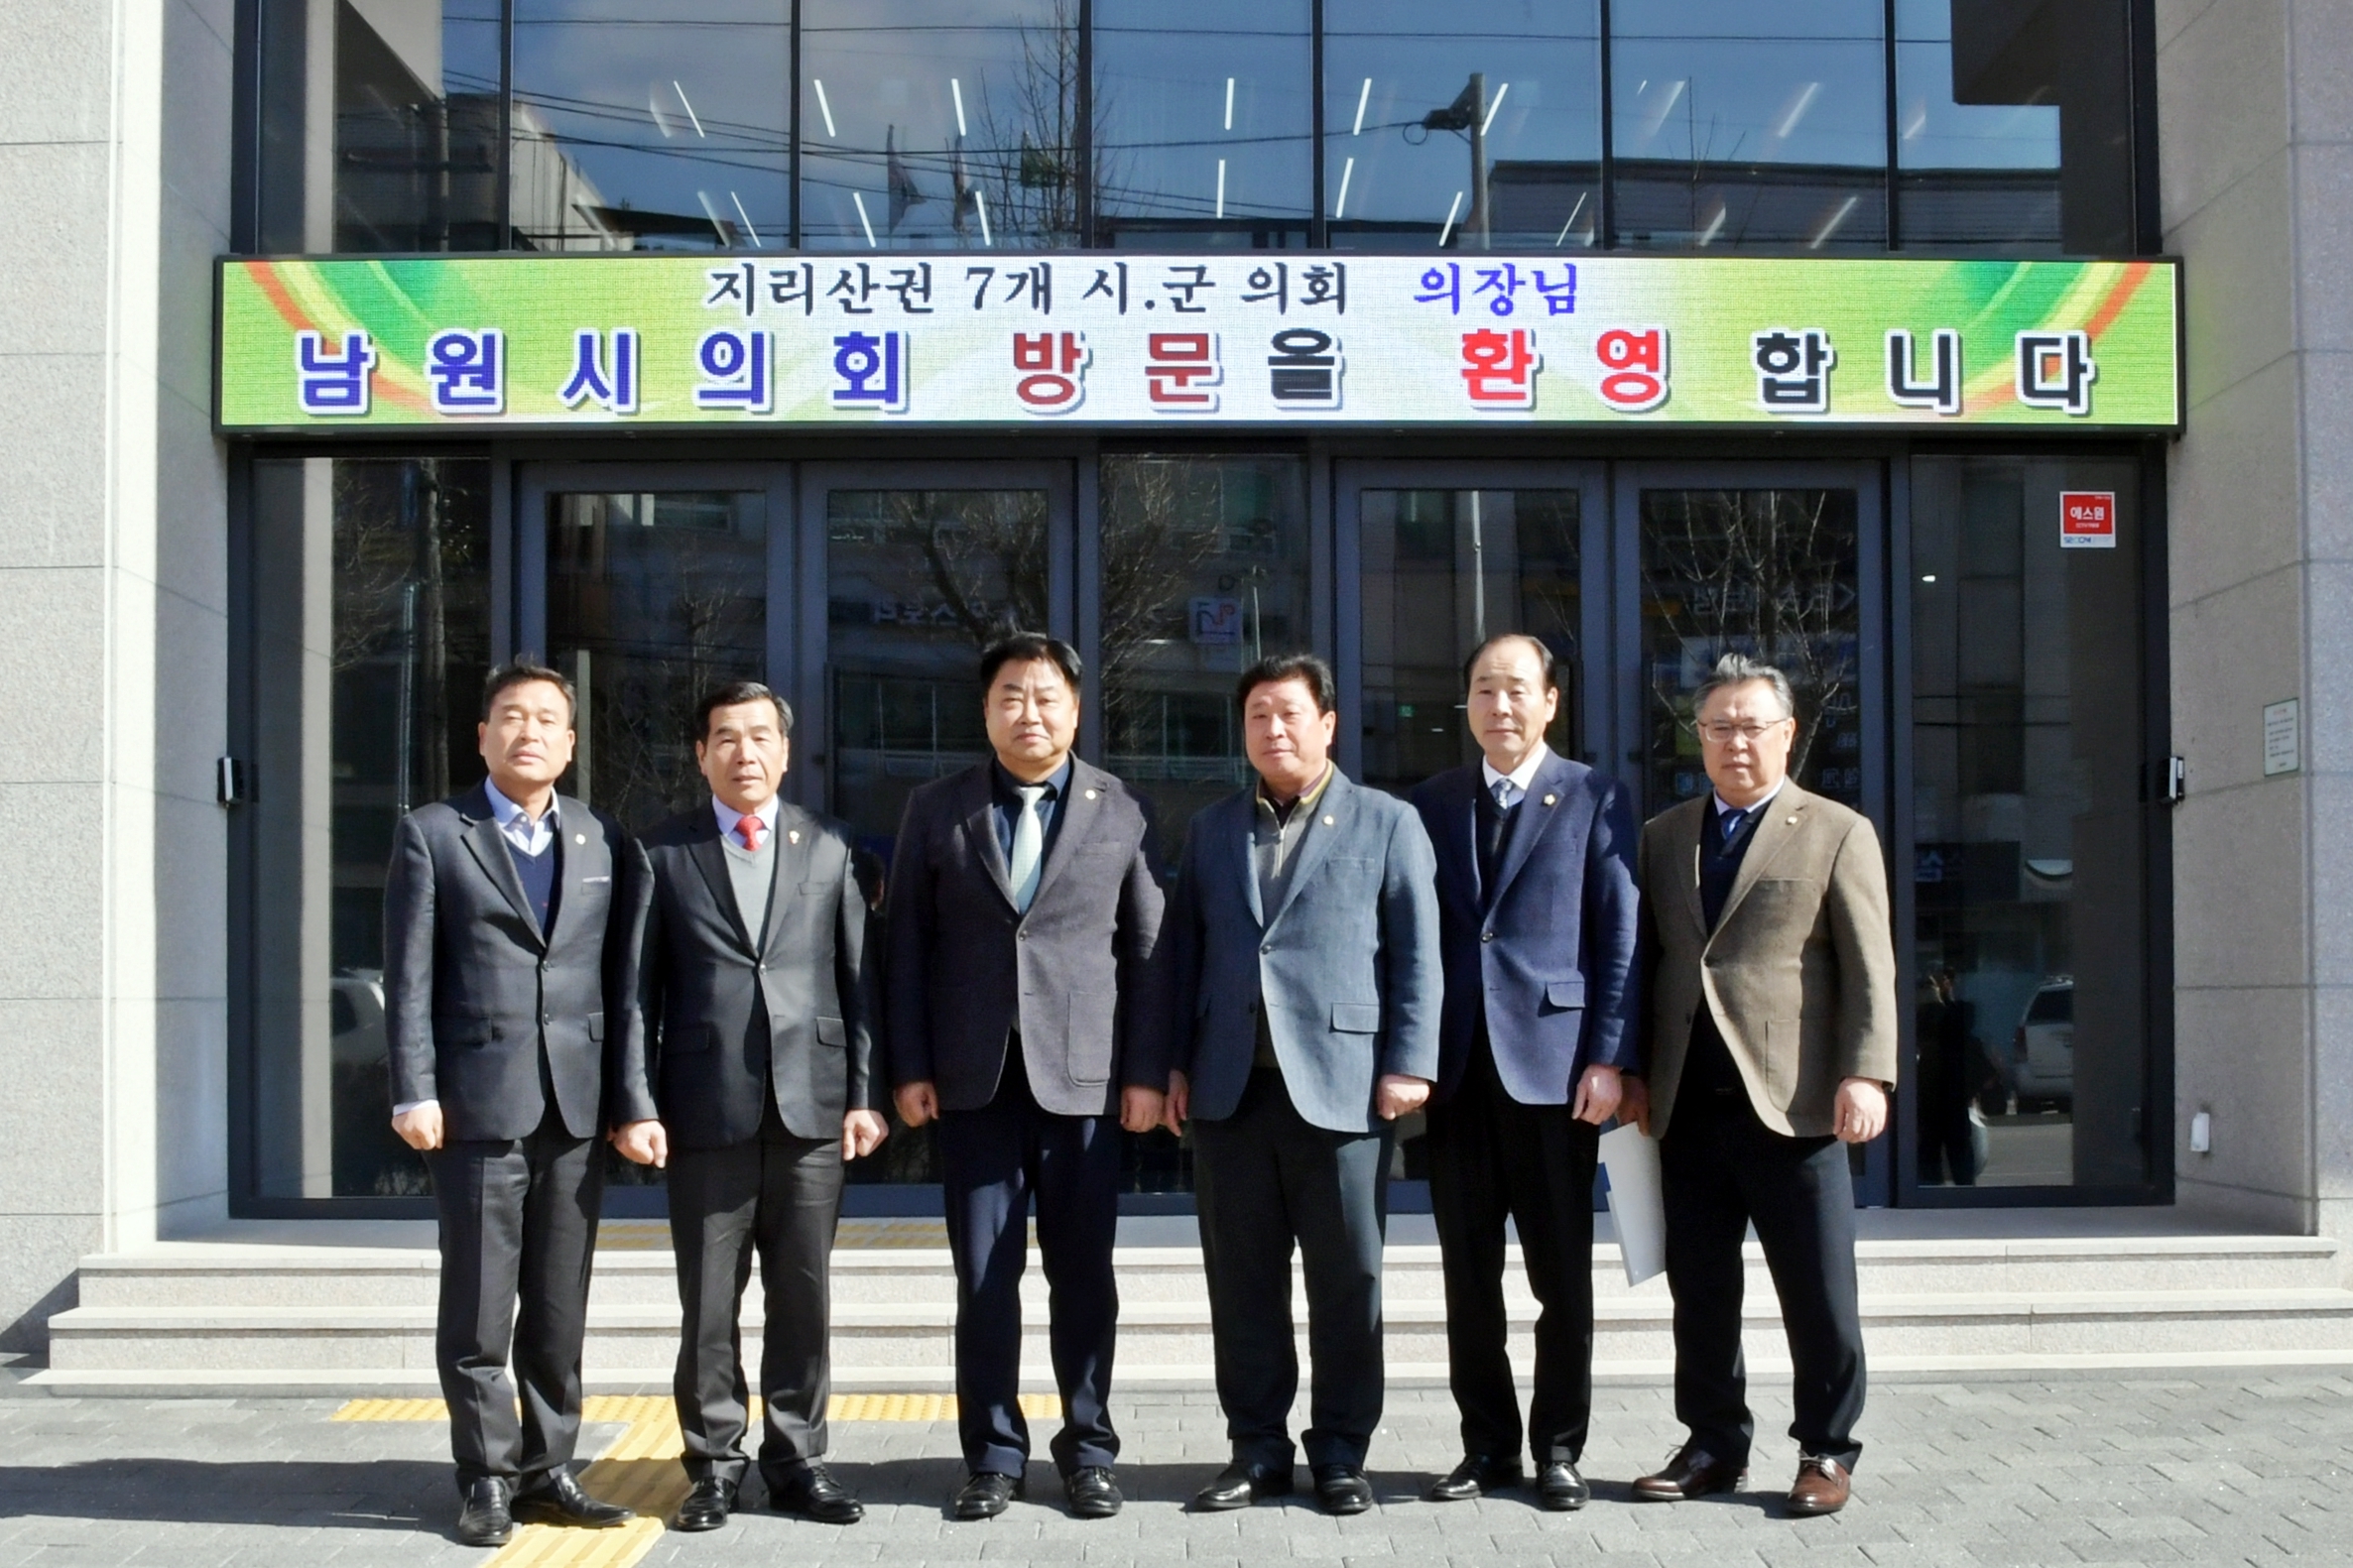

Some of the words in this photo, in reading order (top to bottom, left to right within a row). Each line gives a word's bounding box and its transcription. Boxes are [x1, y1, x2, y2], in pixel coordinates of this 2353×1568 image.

[708, 262, 934, 315] 지리산권
[964, 261, 1053, 315] 7개
[1240, 261, 1346, 315] 의회
[1414, 262, 1577, 315] 의장님
